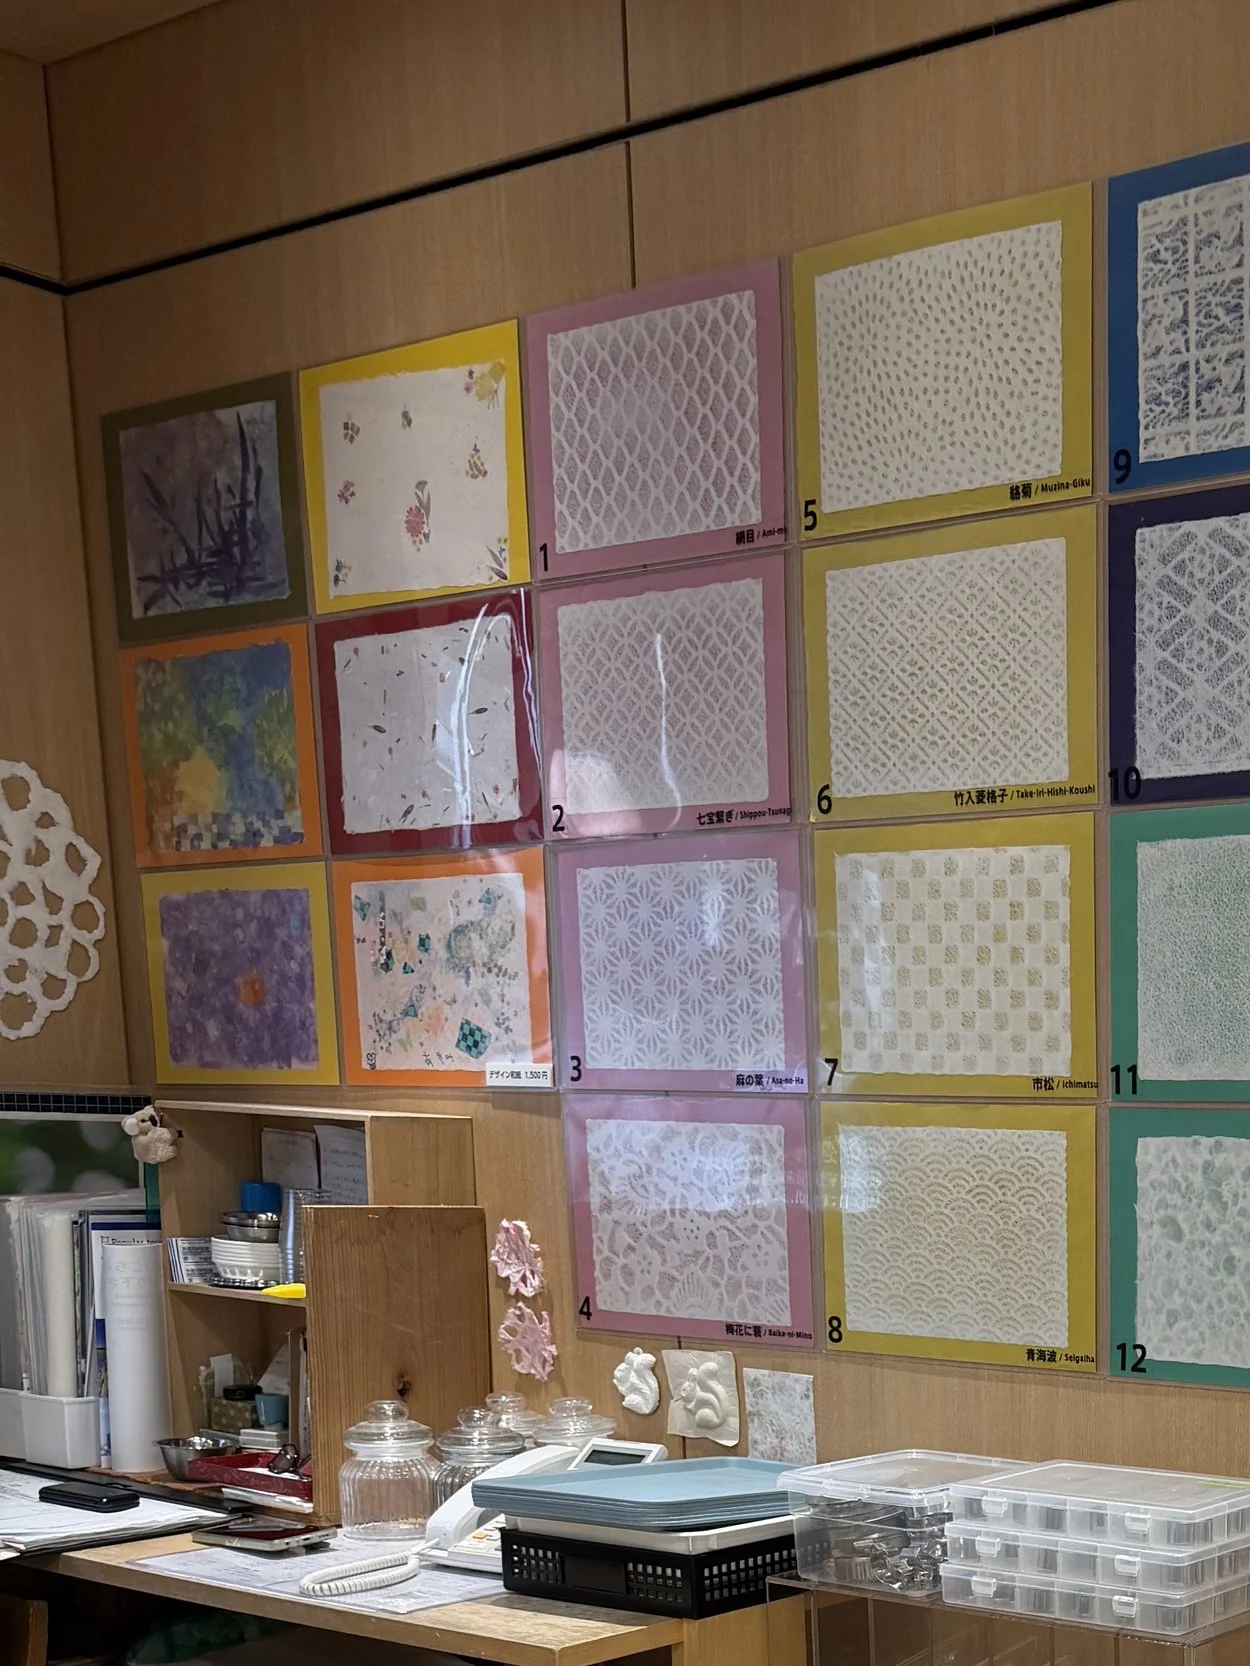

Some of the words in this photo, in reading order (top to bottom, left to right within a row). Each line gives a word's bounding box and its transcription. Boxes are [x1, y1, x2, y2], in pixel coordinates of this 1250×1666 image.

[1113, 448, 1132, 485] 9
[803, 498, 818, 531] 5
[539, 543, 548, 572] 1
[953, 788, 1009, 806] 竹入菱格子
[1015, 783, 1096, 800] Take-Iri-Hishi-Koushi
[1108, 765, 1142, 801] 10
[817, 783, 833, 815] 6
[551, 804, 565, 833] 2
[525, 1069, 548, 1081] 1,500円
[569, 1055, 582, 1082] 3
[735, 1074, 764, 1087] 麻の葉
[771, 1076, 804, 1086] Asa-no-Ha
[824, 1058, 838, 1086] 7
[1110, 1064, 1138, 1096] 11
[1032, 1077, 1055, 1091] 市松
[1062, 1078, 1099, 1090] Ichimatsu
[578, 1296, 592, 1321] 4
[828, 1315, 843, 1343] 8
[1025, 1348, 1057, 1363] 青海波
[1064, 1353, 1095, 1364] Seigaiha
[1116, 1342, 1148, 1374] 12
